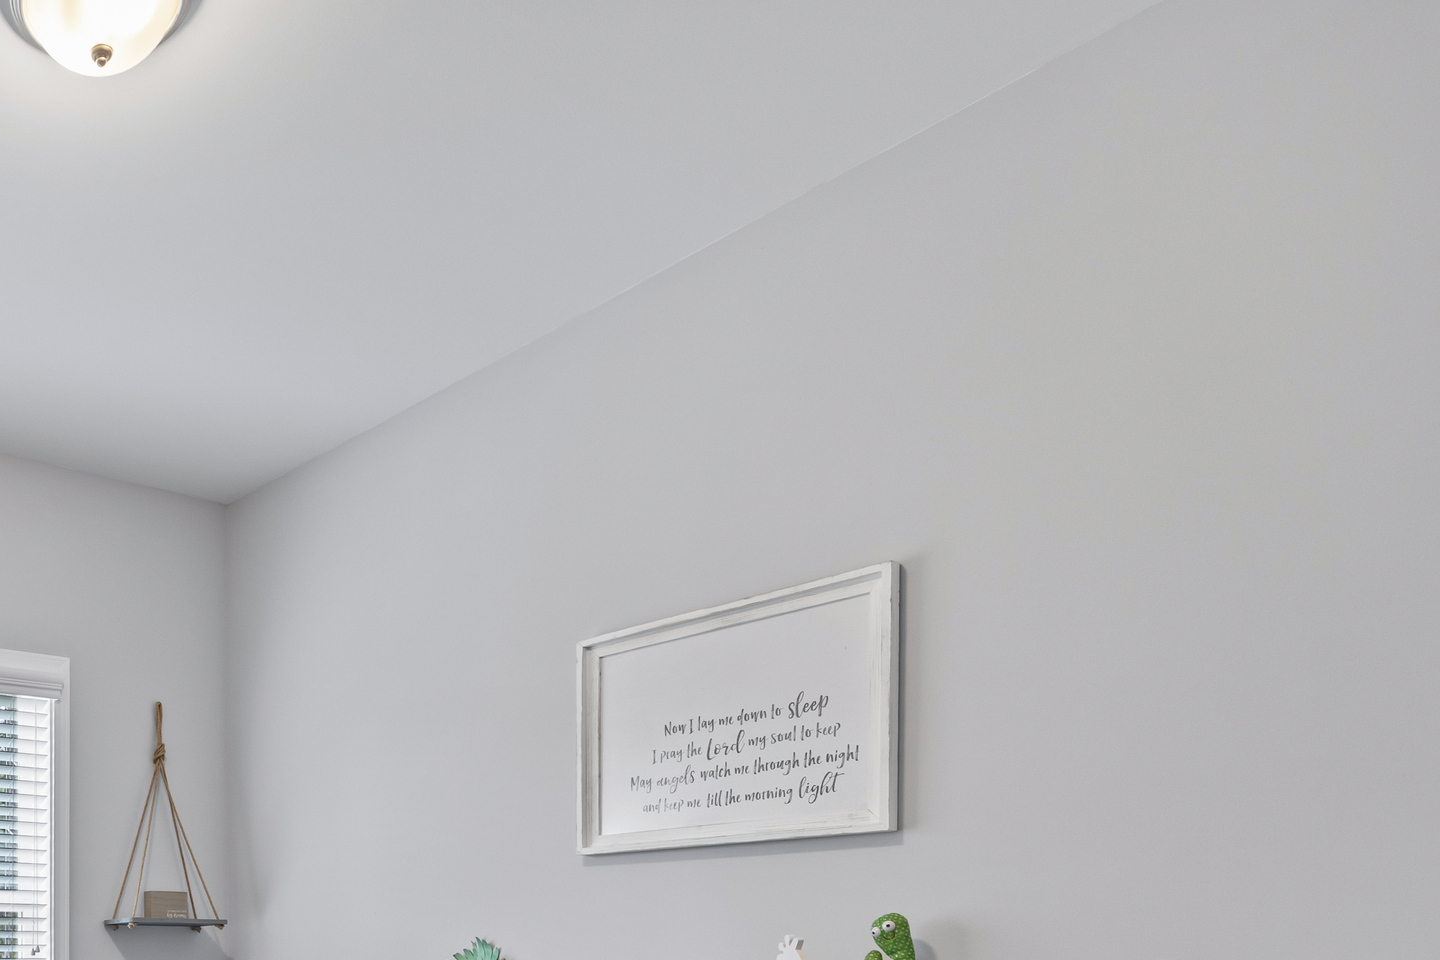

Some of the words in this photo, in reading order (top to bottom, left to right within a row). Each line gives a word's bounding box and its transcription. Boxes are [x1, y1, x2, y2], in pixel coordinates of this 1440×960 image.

[664, 721, 687, 737] Now
[689, 718, 695, 735] I
[697, 715, 715, 733] lay
[718, 715, 735, 726] me
[736, 708, 767, 726] down
[771, 703, 784, 720] to
[788, 690, 829, 720] sleep
[651, 749, 657, 765] I
[659, 748, 683, 764] pray
[686, 741, 703, 759] the
[706, 729, 746, 761] Lord
[748, 736, 768, 750] my
[770, 724, 797, 745] soul
[800, 724, 813, 741] to
[815, 721, 841, 739] keep
[630, 774, 653, 794] May
[656, 764, 696, 795] angels
[700, 761, 731, 782] watch
[734, 765, 750, 777] me
[753, 751, 800, 776] through
[803, 749, 823, 768] the
[825, 743, 860, 770] night
[642, 798, 661, 814] and
[663, 798, 684, 814] keep
[686, 798, 702, 809] me
[706, 789, 723, 808] till
[725, 788, 742, 806] the
[744, 786, 794, 805] morning
[798, 771, 845, 805] light
